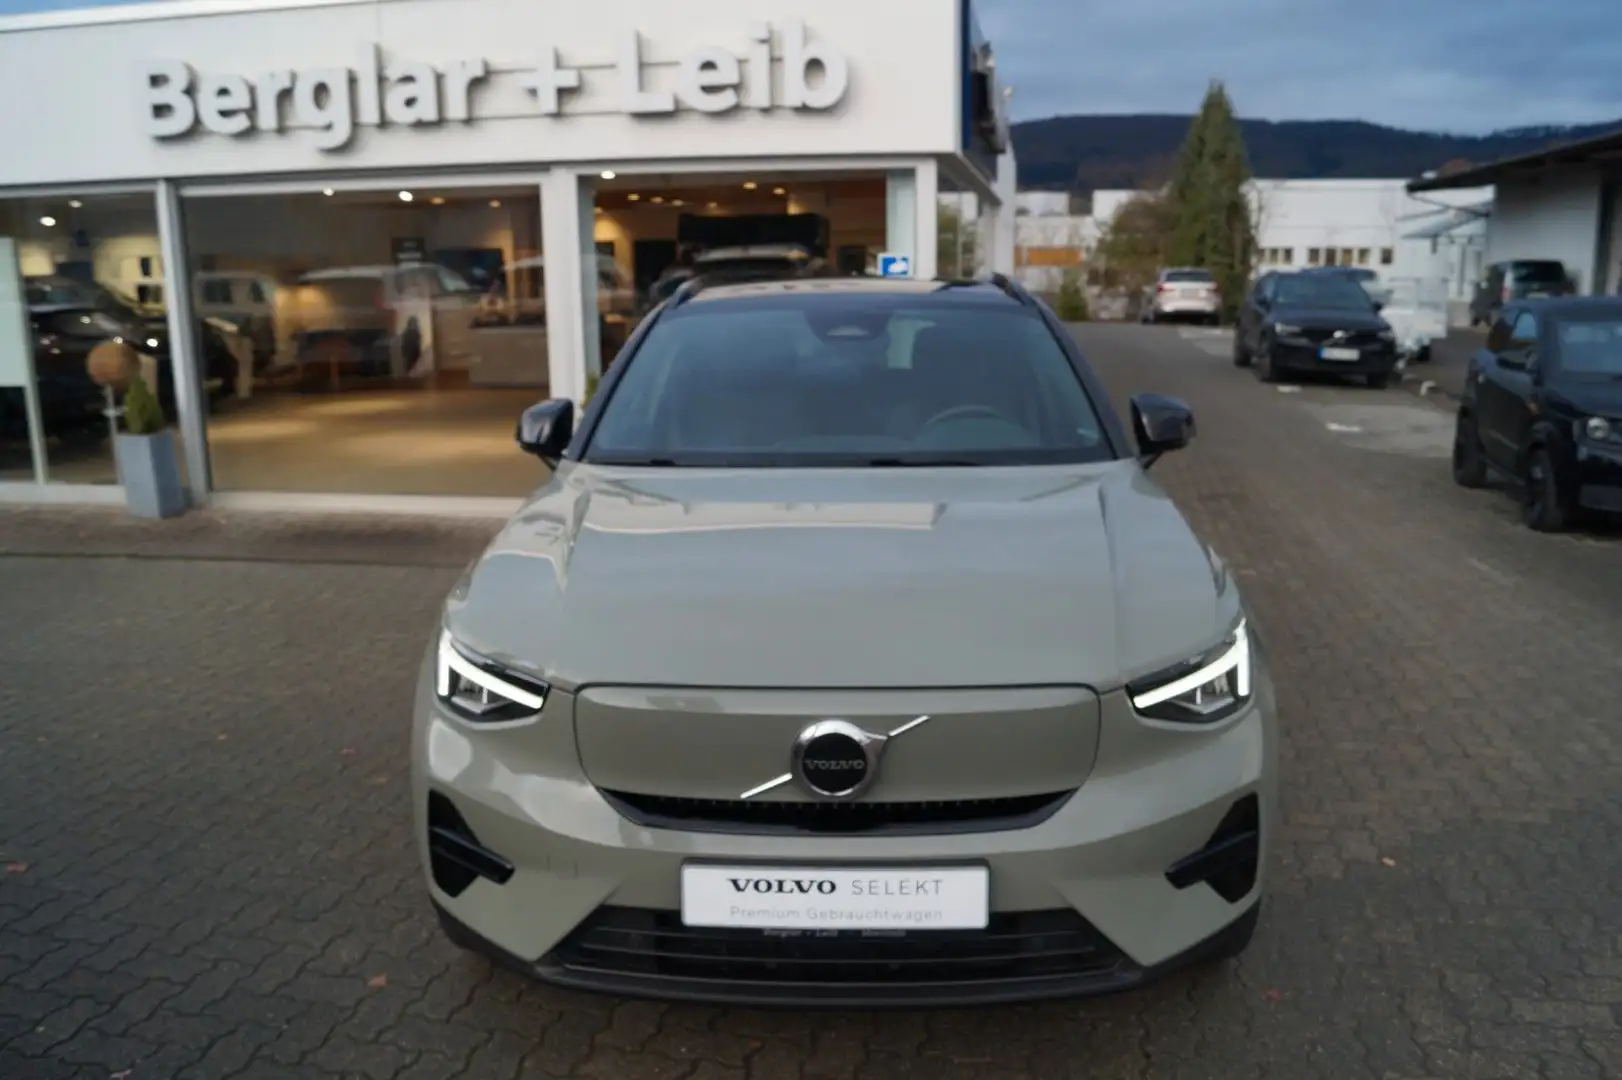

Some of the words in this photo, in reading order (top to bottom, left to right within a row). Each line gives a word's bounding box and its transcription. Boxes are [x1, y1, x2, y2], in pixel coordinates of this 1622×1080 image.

[138, 40, 486, 150] Berglar
[520, 46, 579, 115] +
[620, 22, 848, 112] Leib
[804, 758, 865, 770] VOLVO
[728, 878, 838, 895] VOLVO
[851, 878, 944, 896] SELEKT
[729, 905, 801, 921] Premium
[806, 906, 944, 923] Gebrauchtwagen
